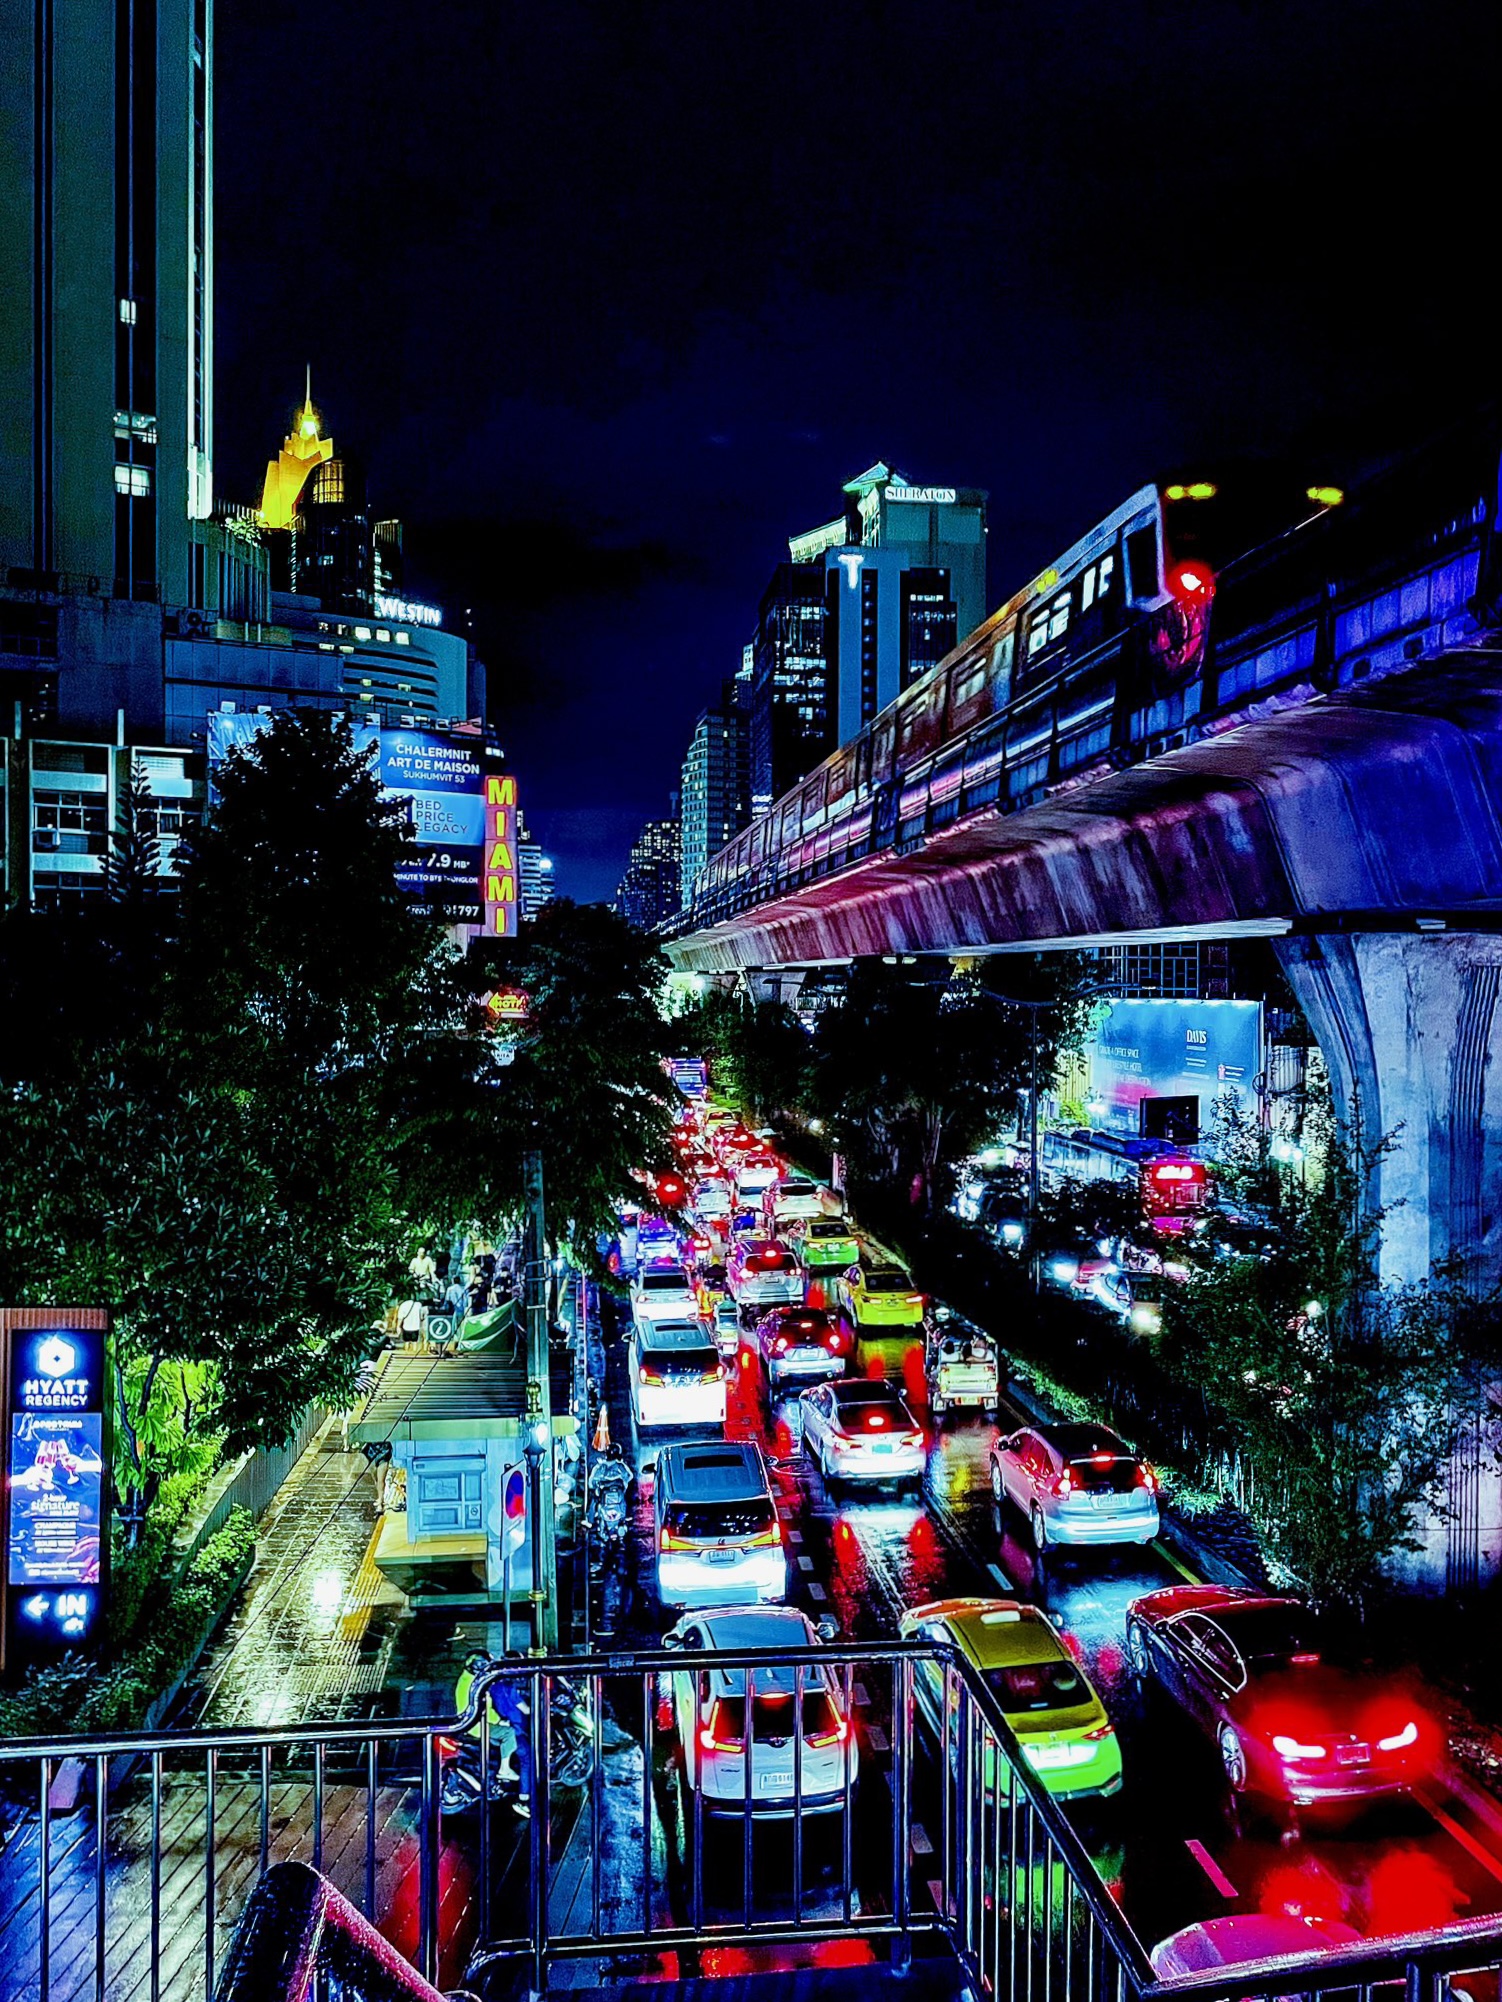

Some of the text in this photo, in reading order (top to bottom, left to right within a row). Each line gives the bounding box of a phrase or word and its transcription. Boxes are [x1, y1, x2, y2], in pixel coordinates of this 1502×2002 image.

[886, 487, 956, 503] SHERATON
[378, 597, 442, 625] WESTIN
[396, 744, 472, 761] CHALERMNIT
[387, 757, 480, 775] ART DE MAISON
[403, 770, 466, 784] SUKHUMVIT 53
[416, 800, 441, 811] BED
[416, 811, 454, 823] PRICE
[487, 778, 514, 935] MIAMI
[25, 1379, 89, 1395] HYATT
[25, 1395, 88, 1407] REGENCY
[58, 1594, 87, 1616] IN
